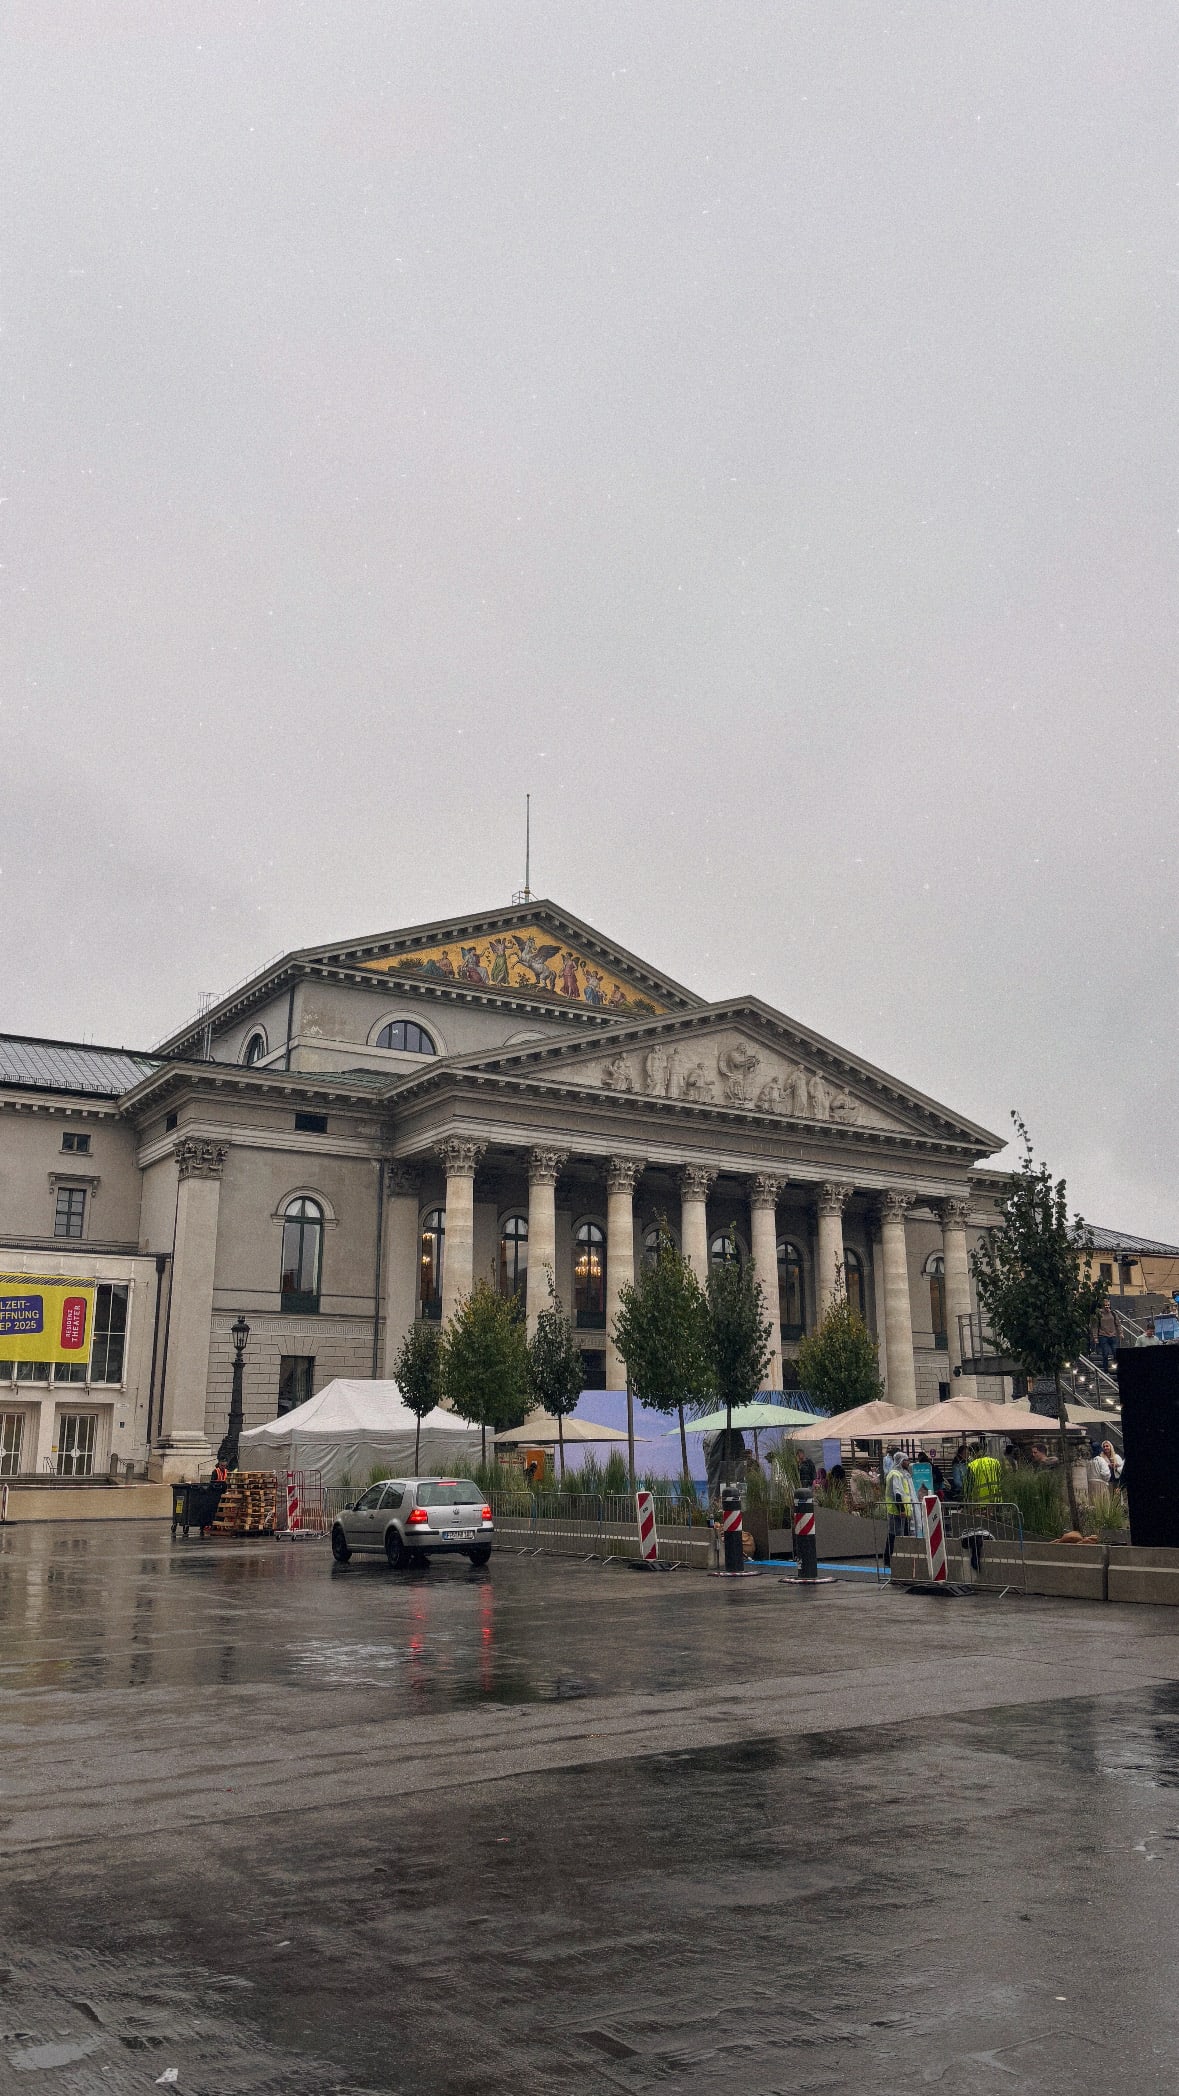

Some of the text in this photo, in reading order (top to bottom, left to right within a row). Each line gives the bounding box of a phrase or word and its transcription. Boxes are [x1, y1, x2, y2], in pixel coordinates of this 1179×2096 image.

[14, 1320, 37, 1330] 2025
[65, 1309, 73, 1338] RESIDENZ
[72, 1305, 81, 1342] THEATER
